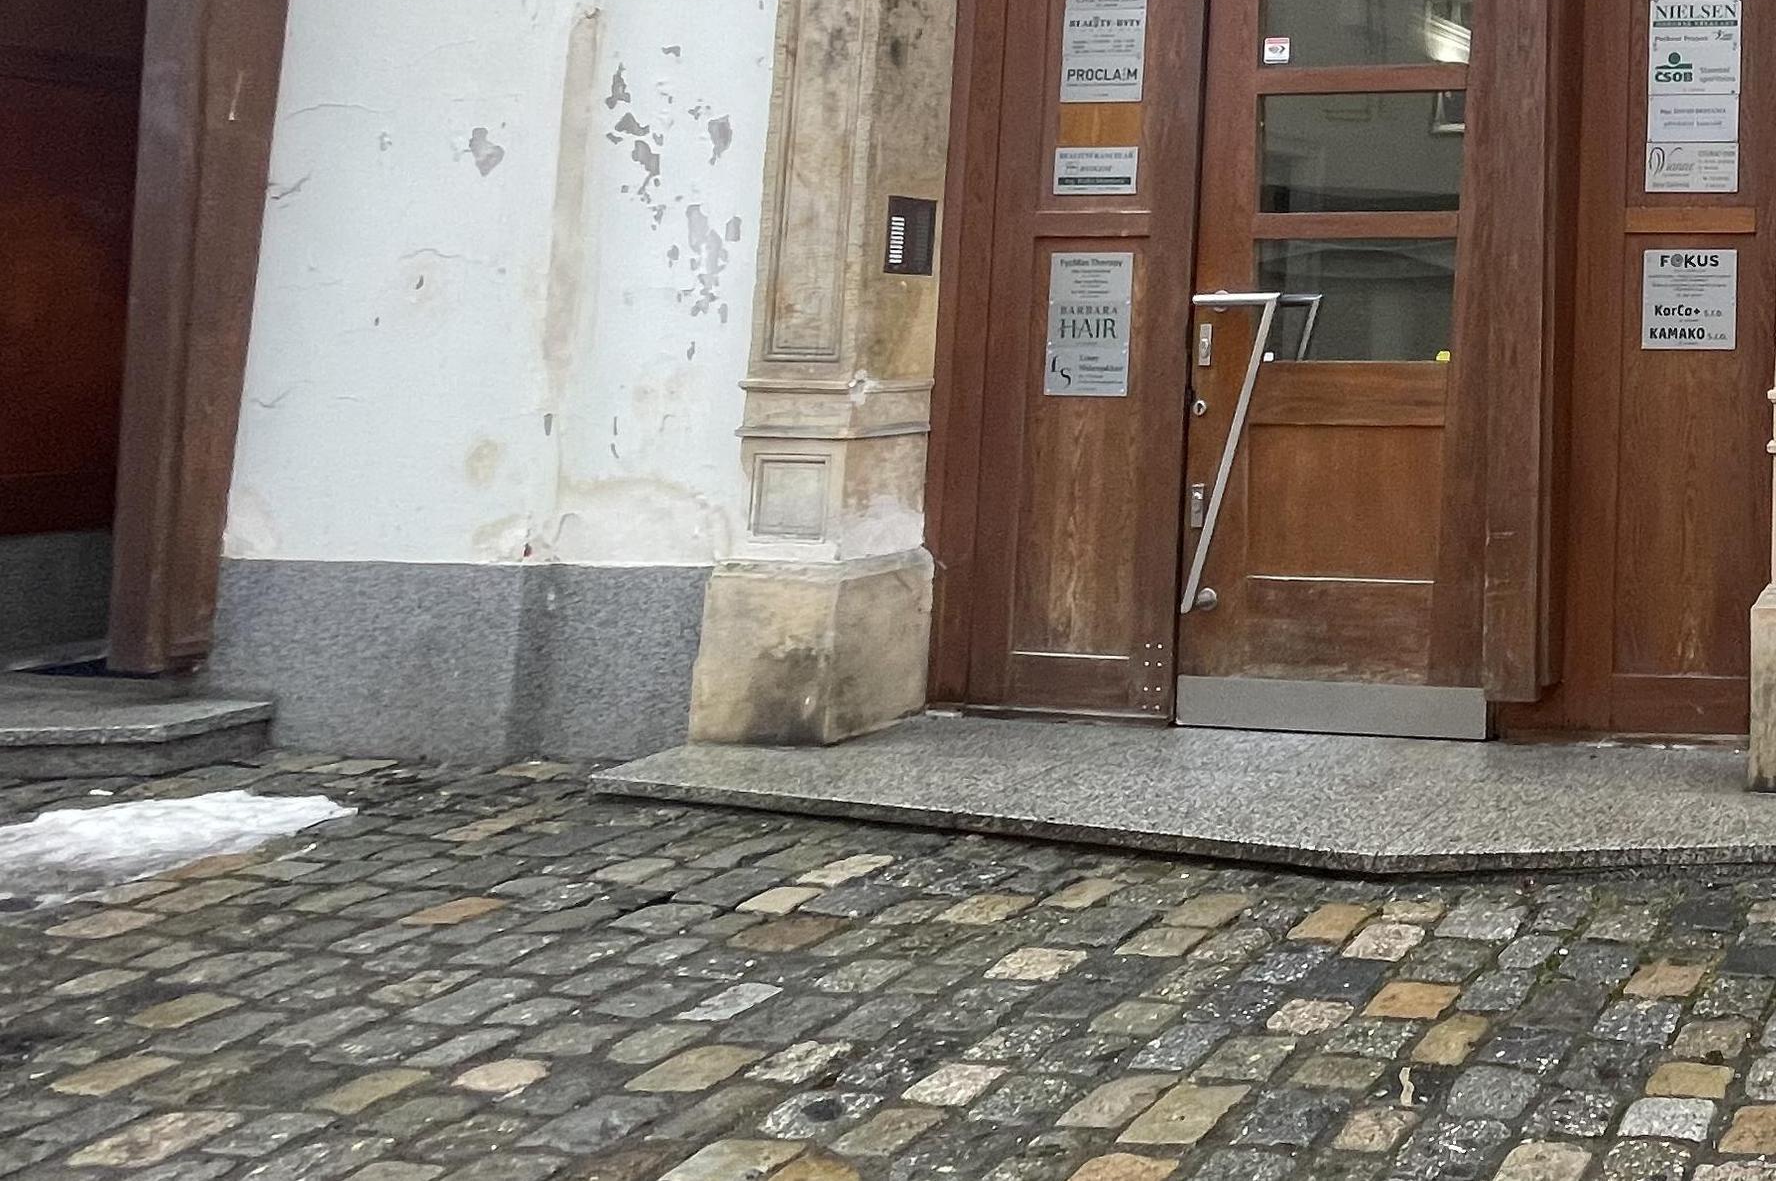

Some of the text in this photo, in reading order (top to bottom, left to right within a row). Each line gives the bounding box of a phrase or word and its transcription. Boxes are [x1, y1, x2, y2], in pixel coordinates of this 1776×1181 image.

[1656, 4, 1736, 18] NIELSEN
[1660, 254, 1720, 268] FOKUS
[1060, 305, 1118, 314] BARBARA
[1060, 318, 1117, 339] HAIR
[1649, 327, 1705, 340] KAMAKO
